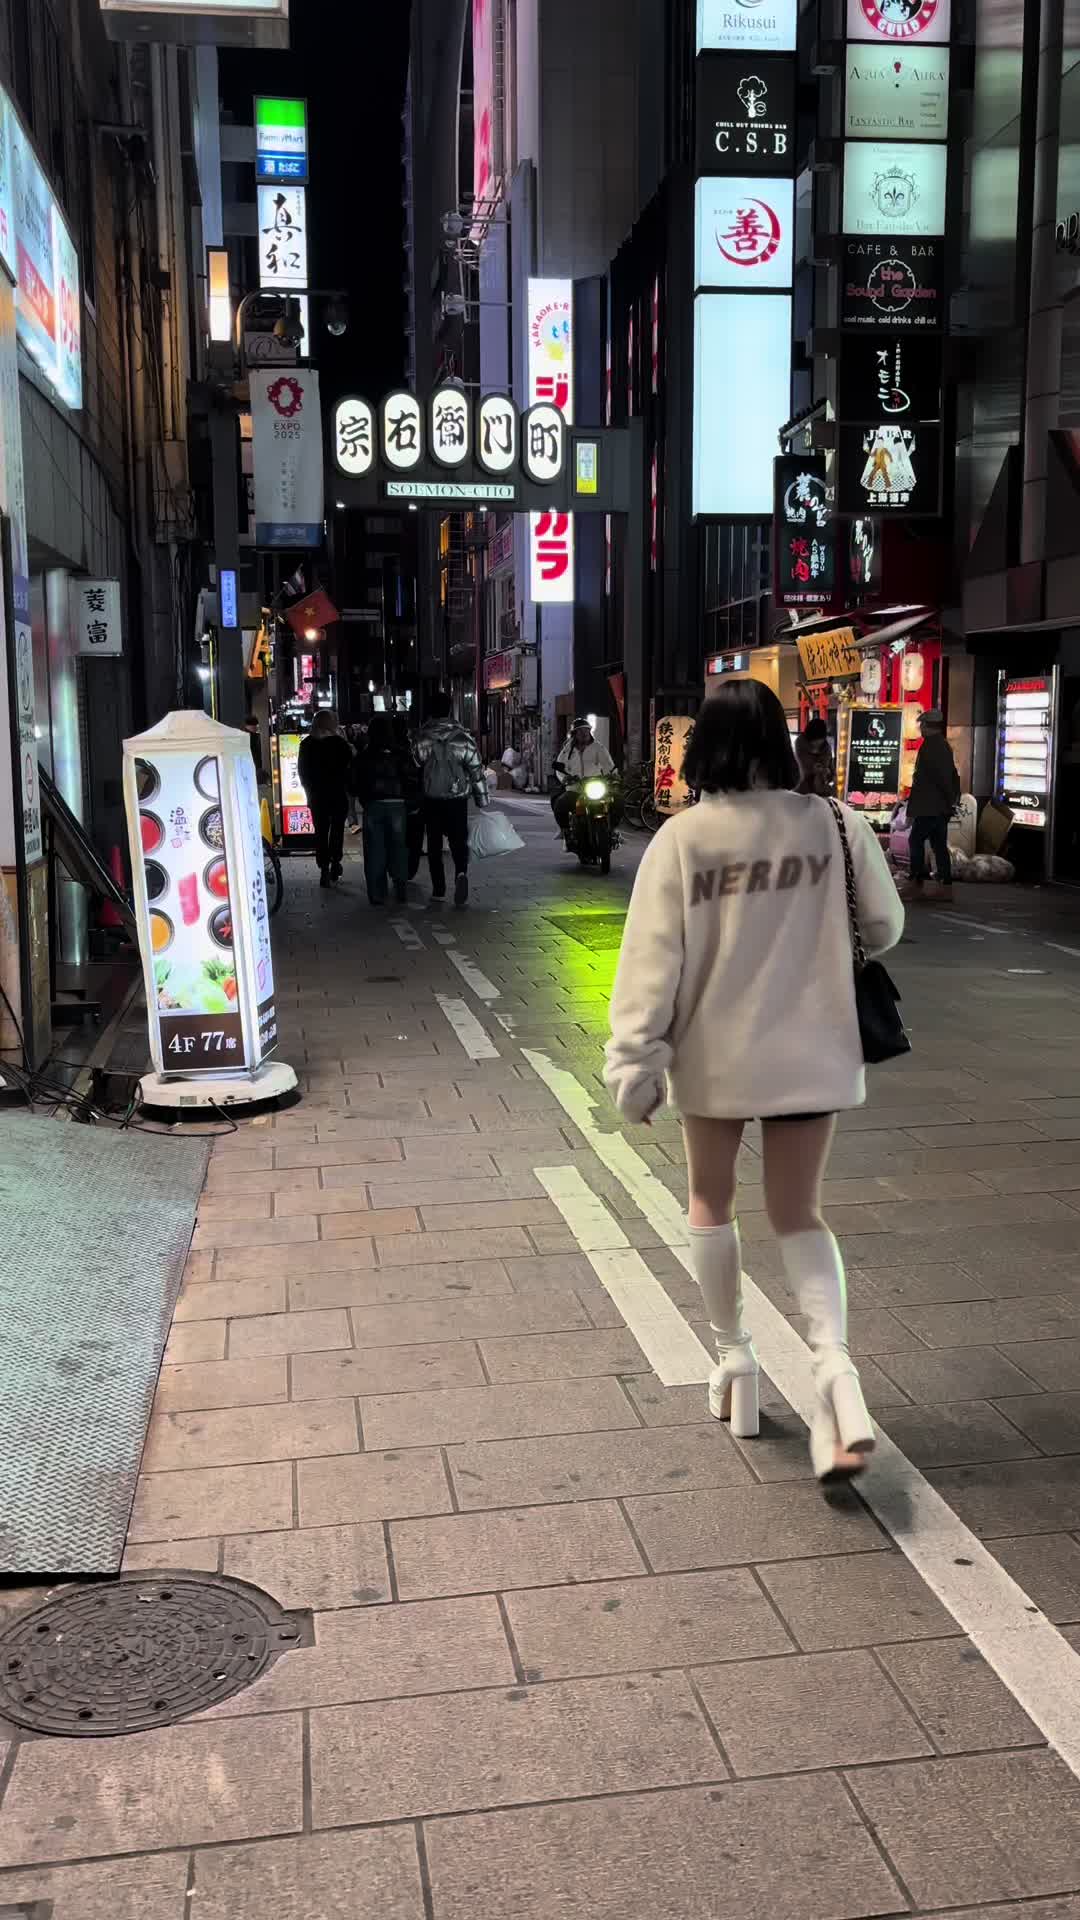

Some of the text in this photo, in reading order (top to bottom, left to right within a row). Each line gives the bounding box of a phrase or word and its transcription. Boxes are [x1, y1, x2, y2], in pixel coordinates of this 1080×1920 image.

[722, 13, 777, 29] Rikusui
[878, 18, 921, 37] GUILD
[715, 121, 734, 129] CHILL
[715, 130, 788, 155] C.S.B
[278, 161, 301, 174] たばこ
[262, 192, 303, 275] 真和
[720, 208, 771, 252] 善
[847, 244, 935, 257] CAFE & BAR
[880, 266, 904, 281] the
[892, 316, 912, 325] drinks
[914, 316, 926, 325] chill
[876, 350, 891, 400] オモニ
[273, 422, 301, 431] EXPO
[273, 431, 301, 439] 2025
[389, 484, 512, 497] SOEMON-CHO
[790, 538, 810, 583] 焼肉
[83, 588, 108, 645] 菱富
[289, 762, 299, 789] コチラ
[288, 810, 310, 820] 無料
[289, 821, 311, 832] 案内
[690, 853, 833, 907] NERDY
[168, 1033, 196, 1054] 4F
